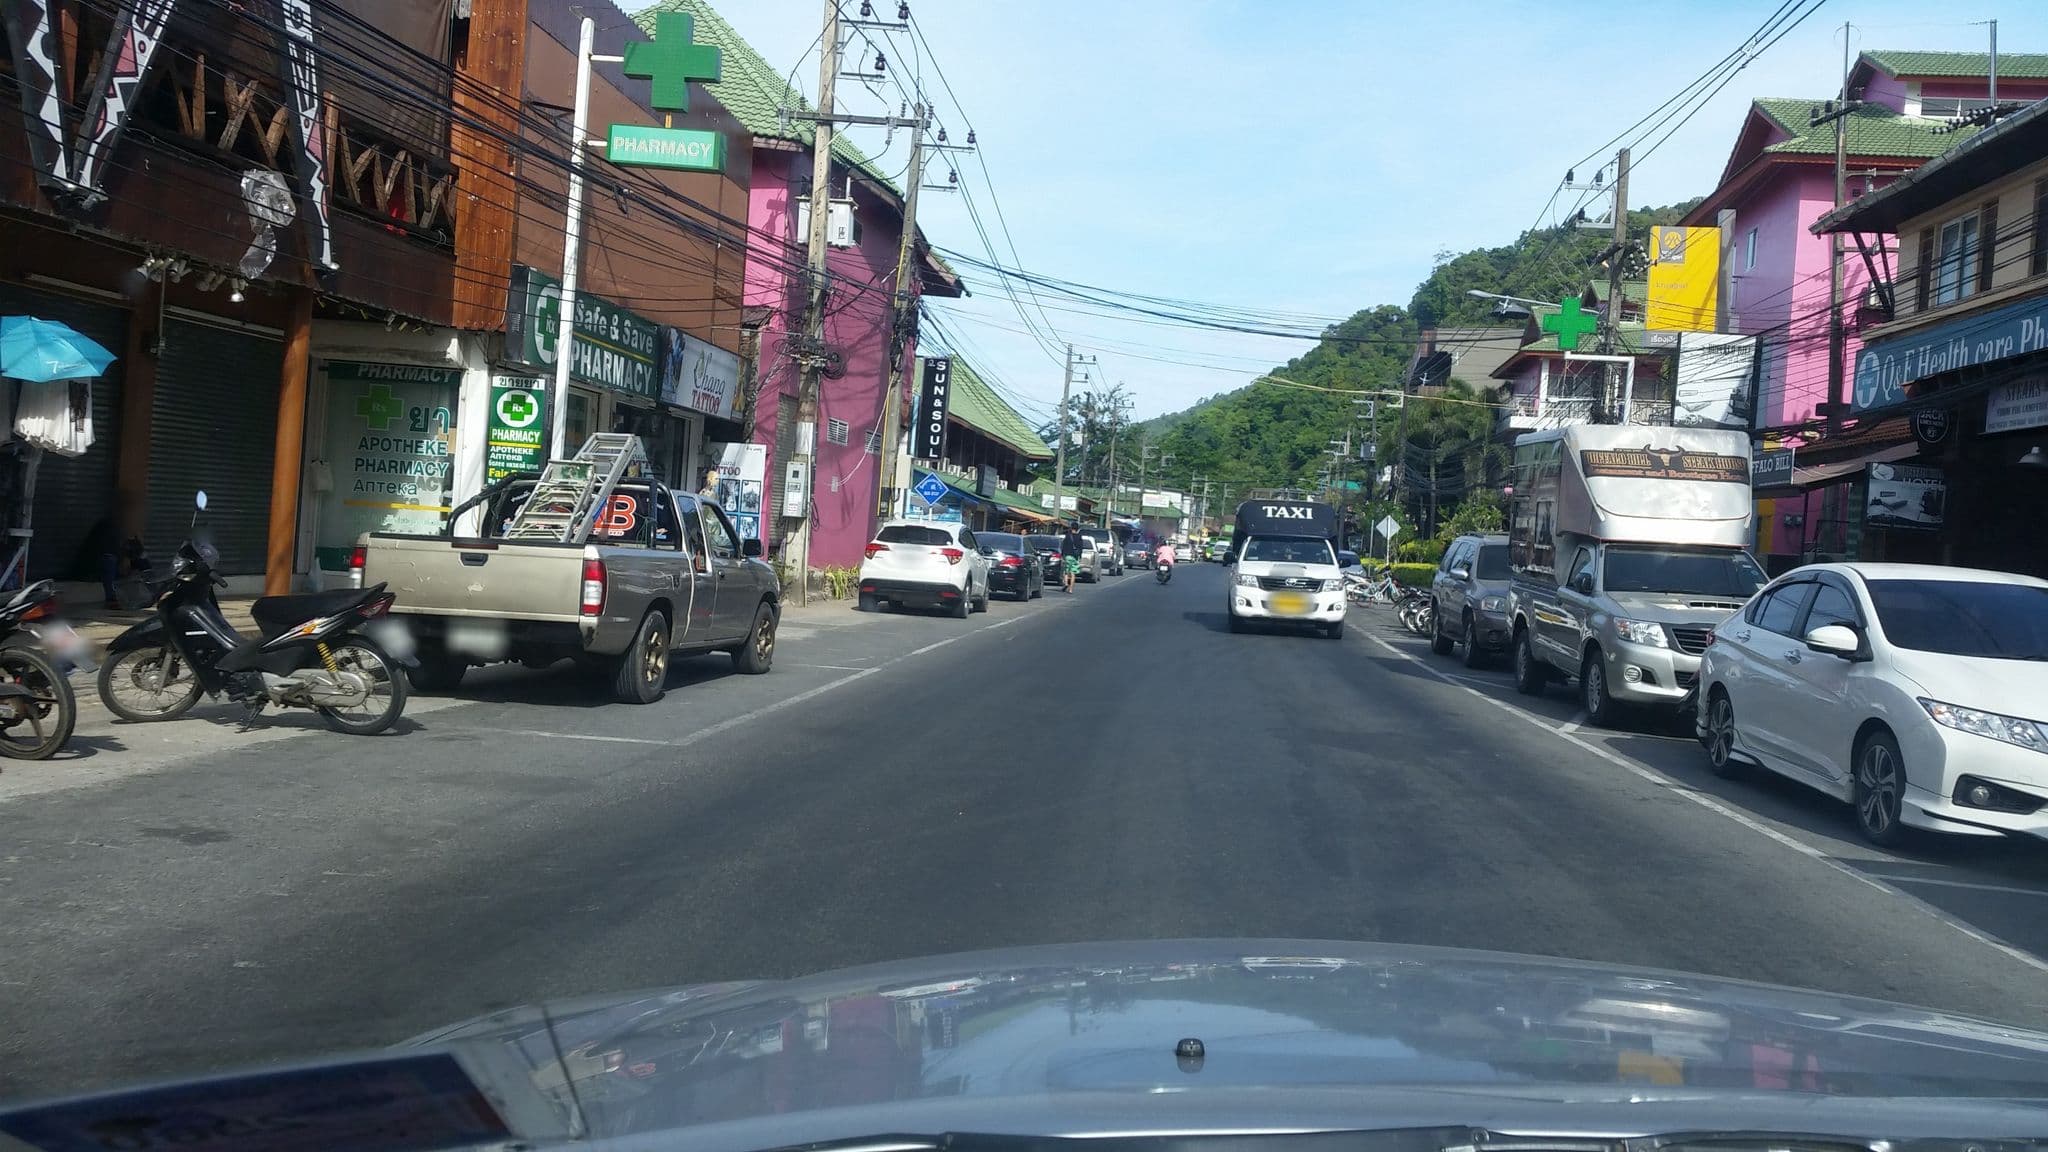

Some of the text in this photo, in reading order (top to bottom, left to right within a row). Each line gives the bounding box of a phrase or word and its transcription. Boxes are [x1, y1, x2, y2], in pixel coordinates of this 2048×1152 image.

[613, 136, 712, 158] PHARMACY
[575, 299, 654, 355] Safe & Save
[1917, 337, 1969, 379] Health
[1974, 335, 2013, 363] care
[2020, 315, 2048, 354] Ph
[357, 363, 452, 383] PHARMACY
[569, 339, 653, 395] PHARMACY
[512, 404, 525, 413] Rx
[690, 388, 721, 414] TATTOO
[409, 406, 451, 434] ยา
[491, 428, 541, 444] PHARMACY
[357, 436, 449, 457] APOTHEKE
[490, 447, 534, 455] APOTHEKE
[354, 457, 450, 478] PHARMACY
[489, 453, 523, 462] Аптека
[1775, 455, 1791, 471] BILL
[353, 479, 418, 496] Аптека
[1262, 505, 1314, 520] TAXI
